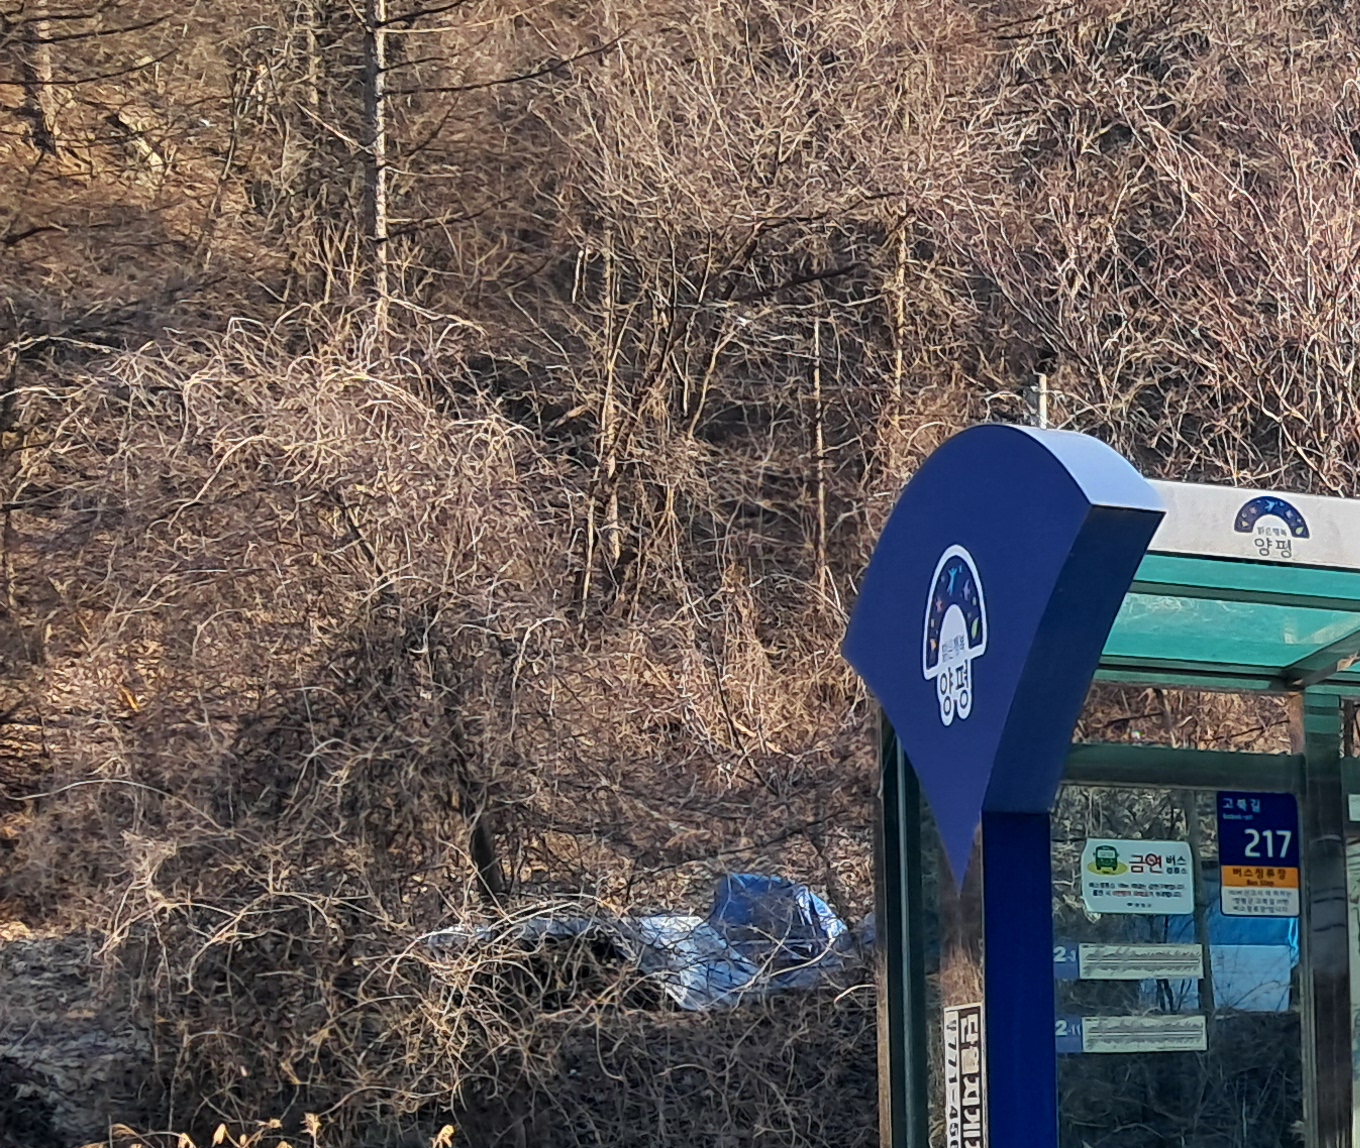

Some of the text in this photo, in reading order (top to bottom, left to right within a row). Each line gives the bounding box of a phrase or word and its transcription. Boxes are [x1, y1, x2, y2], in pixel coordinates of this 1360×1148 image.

[1254, 537, 1292, 558] 양평
[939, 658, 969, 716] 양평
[1243, 828, 1293, 859] 217
[1129, 853, 1187, 875] 금연 버스
